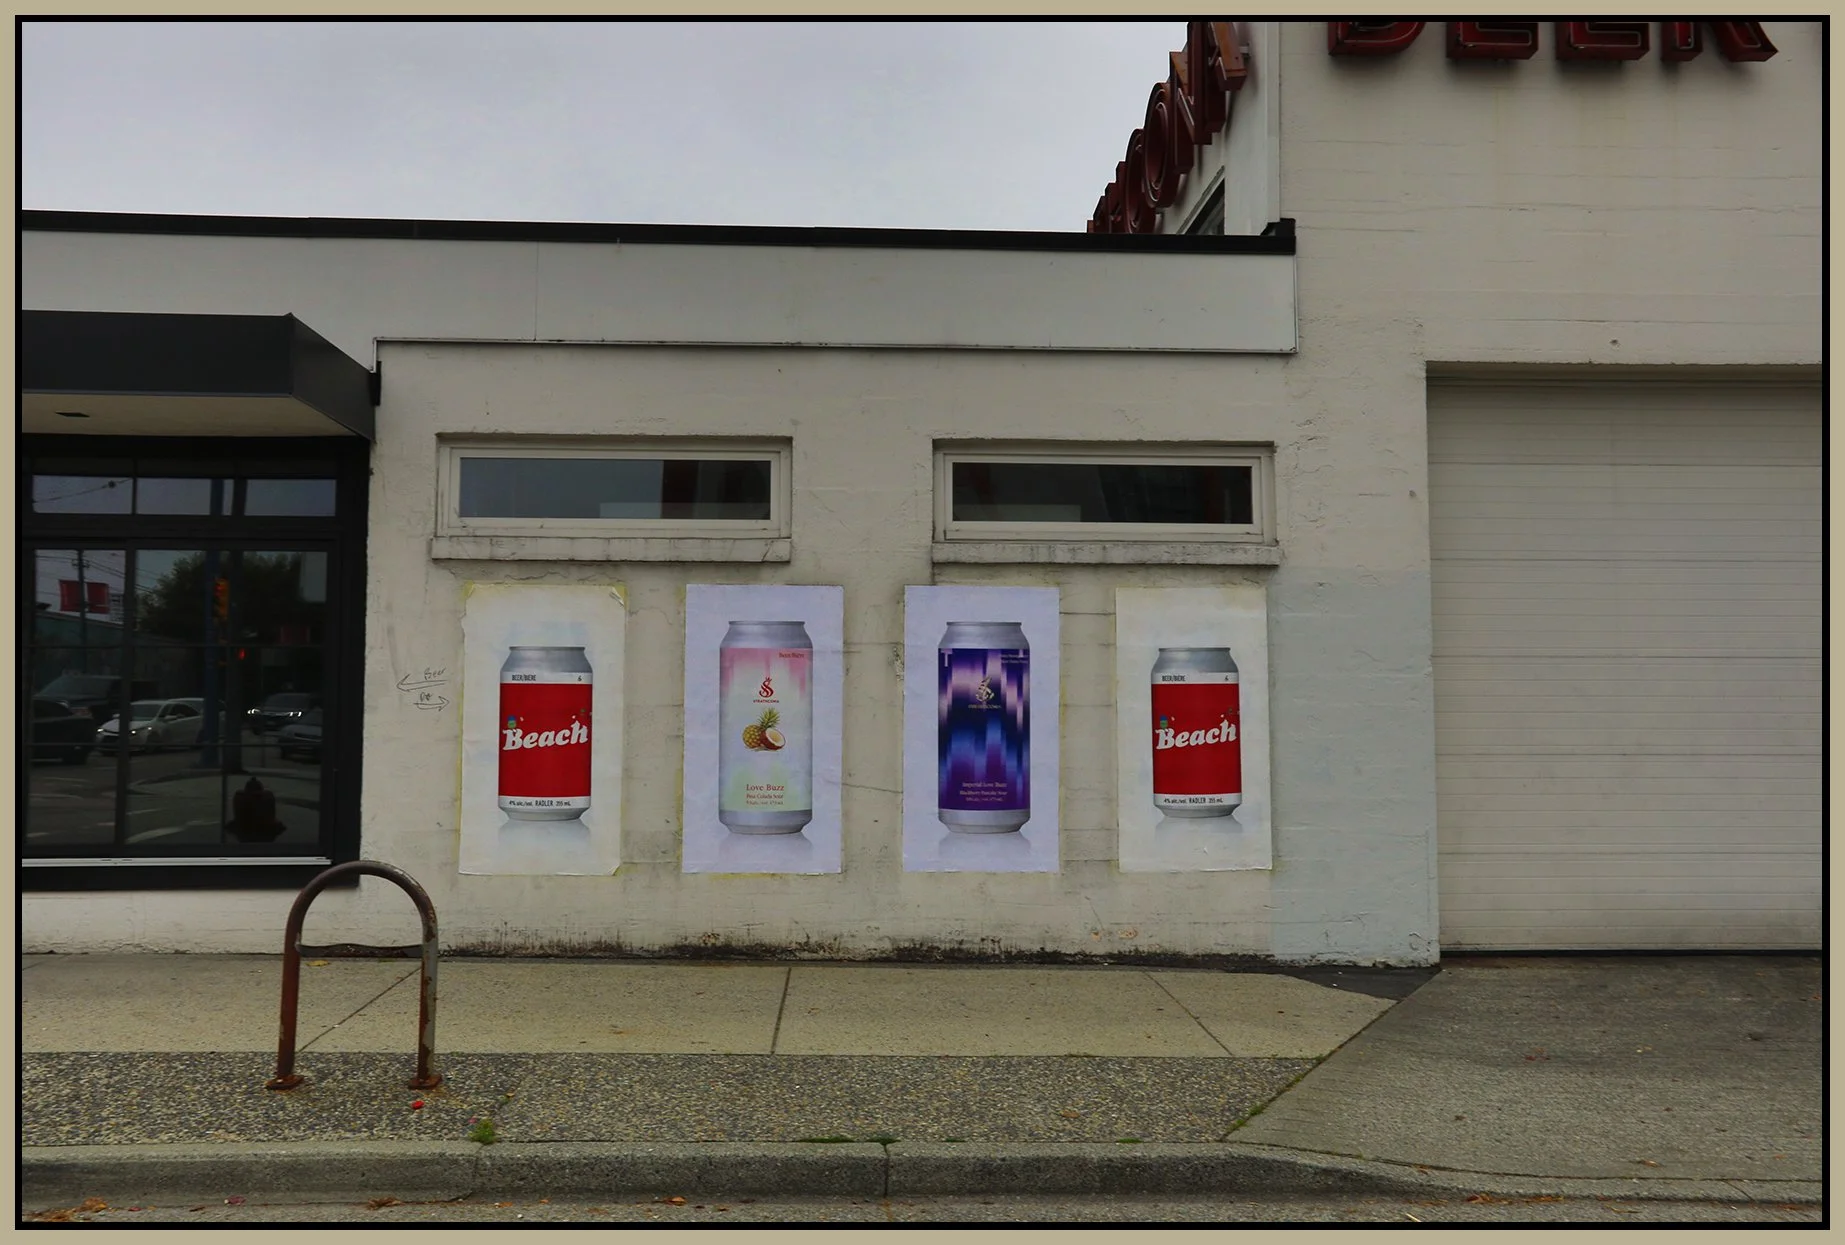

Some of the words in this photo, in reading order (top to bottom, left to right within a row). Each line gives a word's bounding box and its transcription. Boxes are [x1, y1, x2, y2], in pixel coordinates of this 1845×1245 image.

[502, 720, 588, 751] Beach
[1155, 719, 1237, 750] Beach
[746, 783, 764, 791] Love
[766, 783, 785, 791] Buzz
